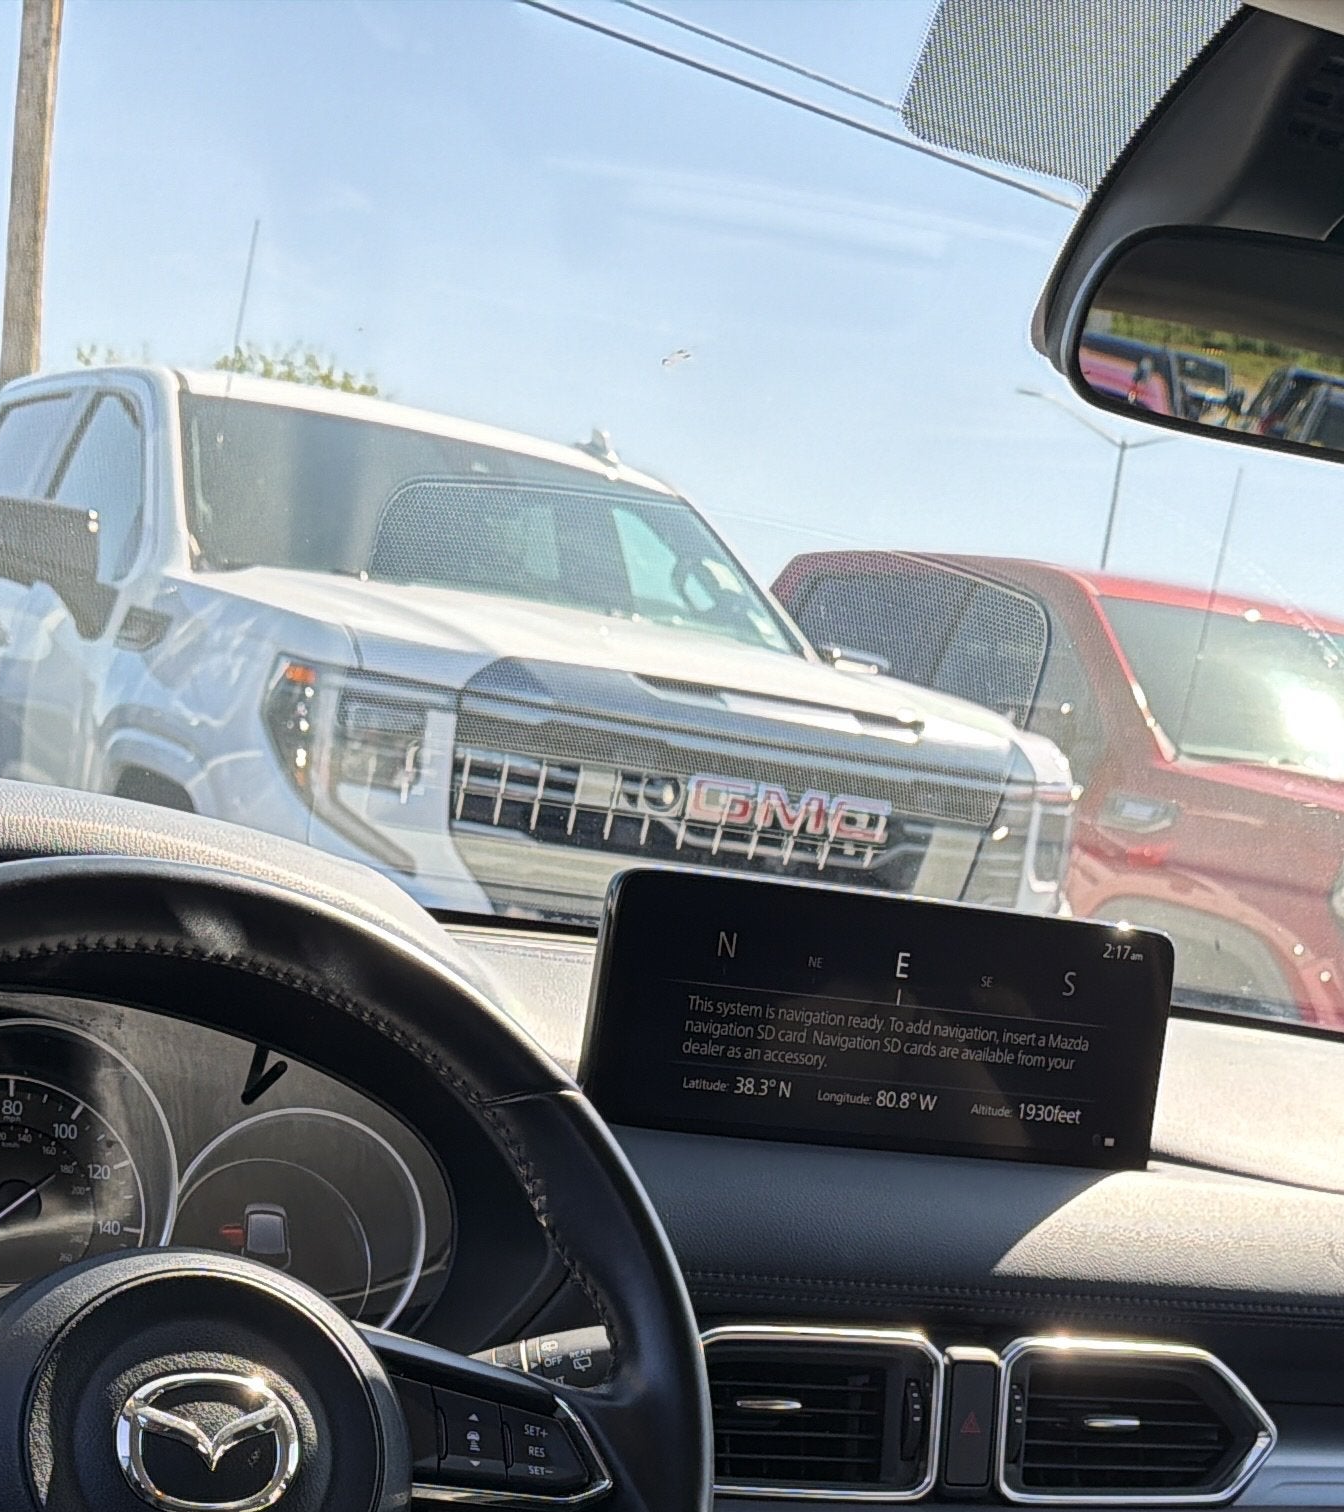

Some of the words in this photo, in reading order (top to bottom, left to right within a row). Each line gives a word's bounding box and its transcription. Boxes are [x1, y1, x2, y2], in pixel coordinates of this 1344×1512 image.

[686, 774, 892, 845] GMC
[717, 931, 737, 958] N
[808, 956, 824, 969] NE
[896, 952, 911, 978] E
[980, 975, 993, 988] SE
[1062, 971, 1077, 996] S
[688, 995, 713, 1013] This
[717, 1001, 762, 1018] system
[766, 1004, 775, 1019] is
[778, 1007, 844, 1027] navigation
[847, 1014, 885, 1033] ready.
[889, 1017, 903, 1032] To
[906, 1020, 931, 1036] add
[933, 1024, 999, 1044] navigation,
[1002, 1028, 1036, 1045] insert
[1037, 1034, 1045, 1047] a
[1048, 1034, 1089, 1052] Mazda
[685, 1019, 754, 1039] navigation
[756, 1024, 775, 1040] SD
[812, 1031, 880, 1052] Navigation
[883, 1037, 901, 1053] SD
[903, 1041, 936, 1057] cards
[938, 1046, 959, 1060] are
[961, 1047, 1015, 1064] available
[1017, 1051, 1045, 1068] from
[1047, 1057, 1075, 1071] your
[682, 1038, 723, 1057] dealer
[727, 1044, 741, 1059] as
[744, 1047, 761, 1061] an
[763, 1049, 828, 1070] accessory.
[682, 1077, 730, 1093] Latitude:
[778, 1081, 792, 1098] N
[817, 1090, 872, 1106] Longitude:
[919, 1095, 938, 1111] W
[970, 1103, 1013, 1118] Altitude:
[1, 1099, 23, 1117] 80
[17, 1133, 32, 1143] 140
[52, 1123, 78, 1140] 100
[42, 1146, 56, 1156] 160
[87, 1163, 110, 1180] 120
[97, 1220, 121, 1236] 140
[544, 1355, 563, 1368] OFF
[569, 1348, 592, 1359] REAR
[528, 1446, 546, 1458] RES
